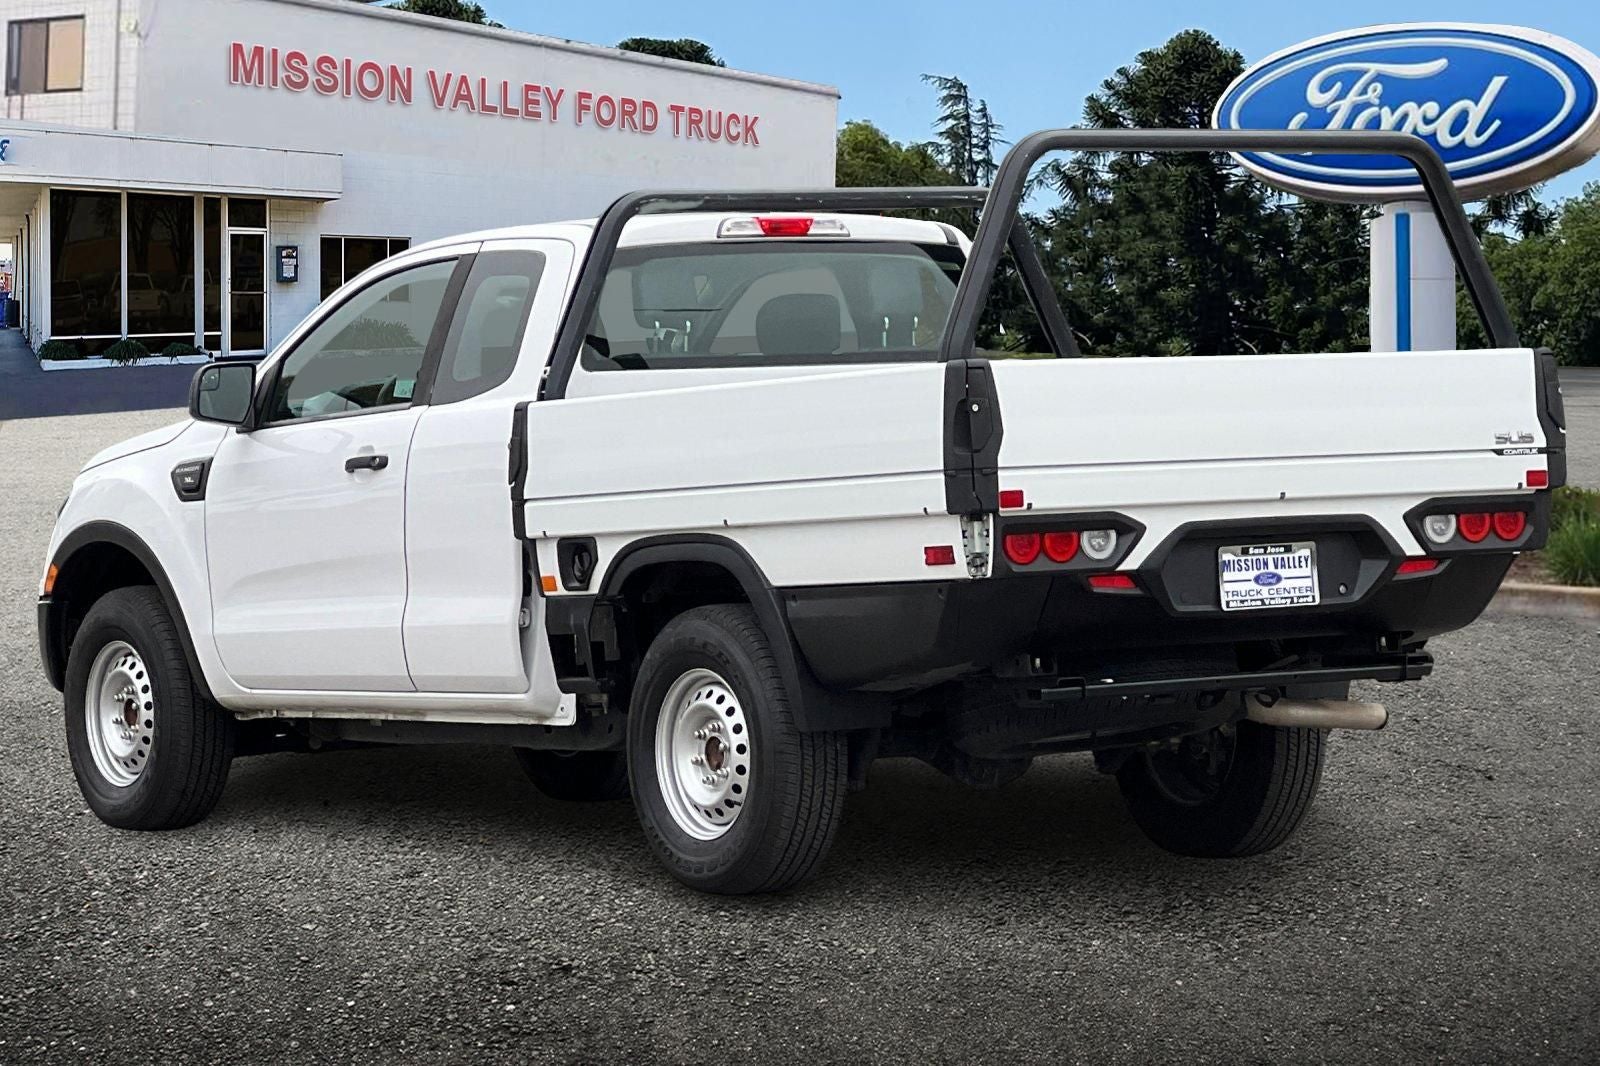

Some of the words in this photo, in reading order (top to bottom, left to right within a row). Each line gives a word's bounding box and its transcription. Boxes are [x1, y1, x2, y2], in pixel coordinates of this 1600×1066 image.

[229, 40, 414, 105] MISSION
[427, 69, 565, 122] VALLEY
[576, 89, 660, 135] FORD
[669, 103, 761, 147] TRUCK
[1287, 56, 1509, 150] Ford
[1222, 558, 1268, 572] MISSION
[1272, 555, 1309, 569] VALLEY
[1258, 573, 1277, 584] Ford
[1225, 588, 1263, 599] TRUCK
[1267, 586, 1313, 596] CENTER
